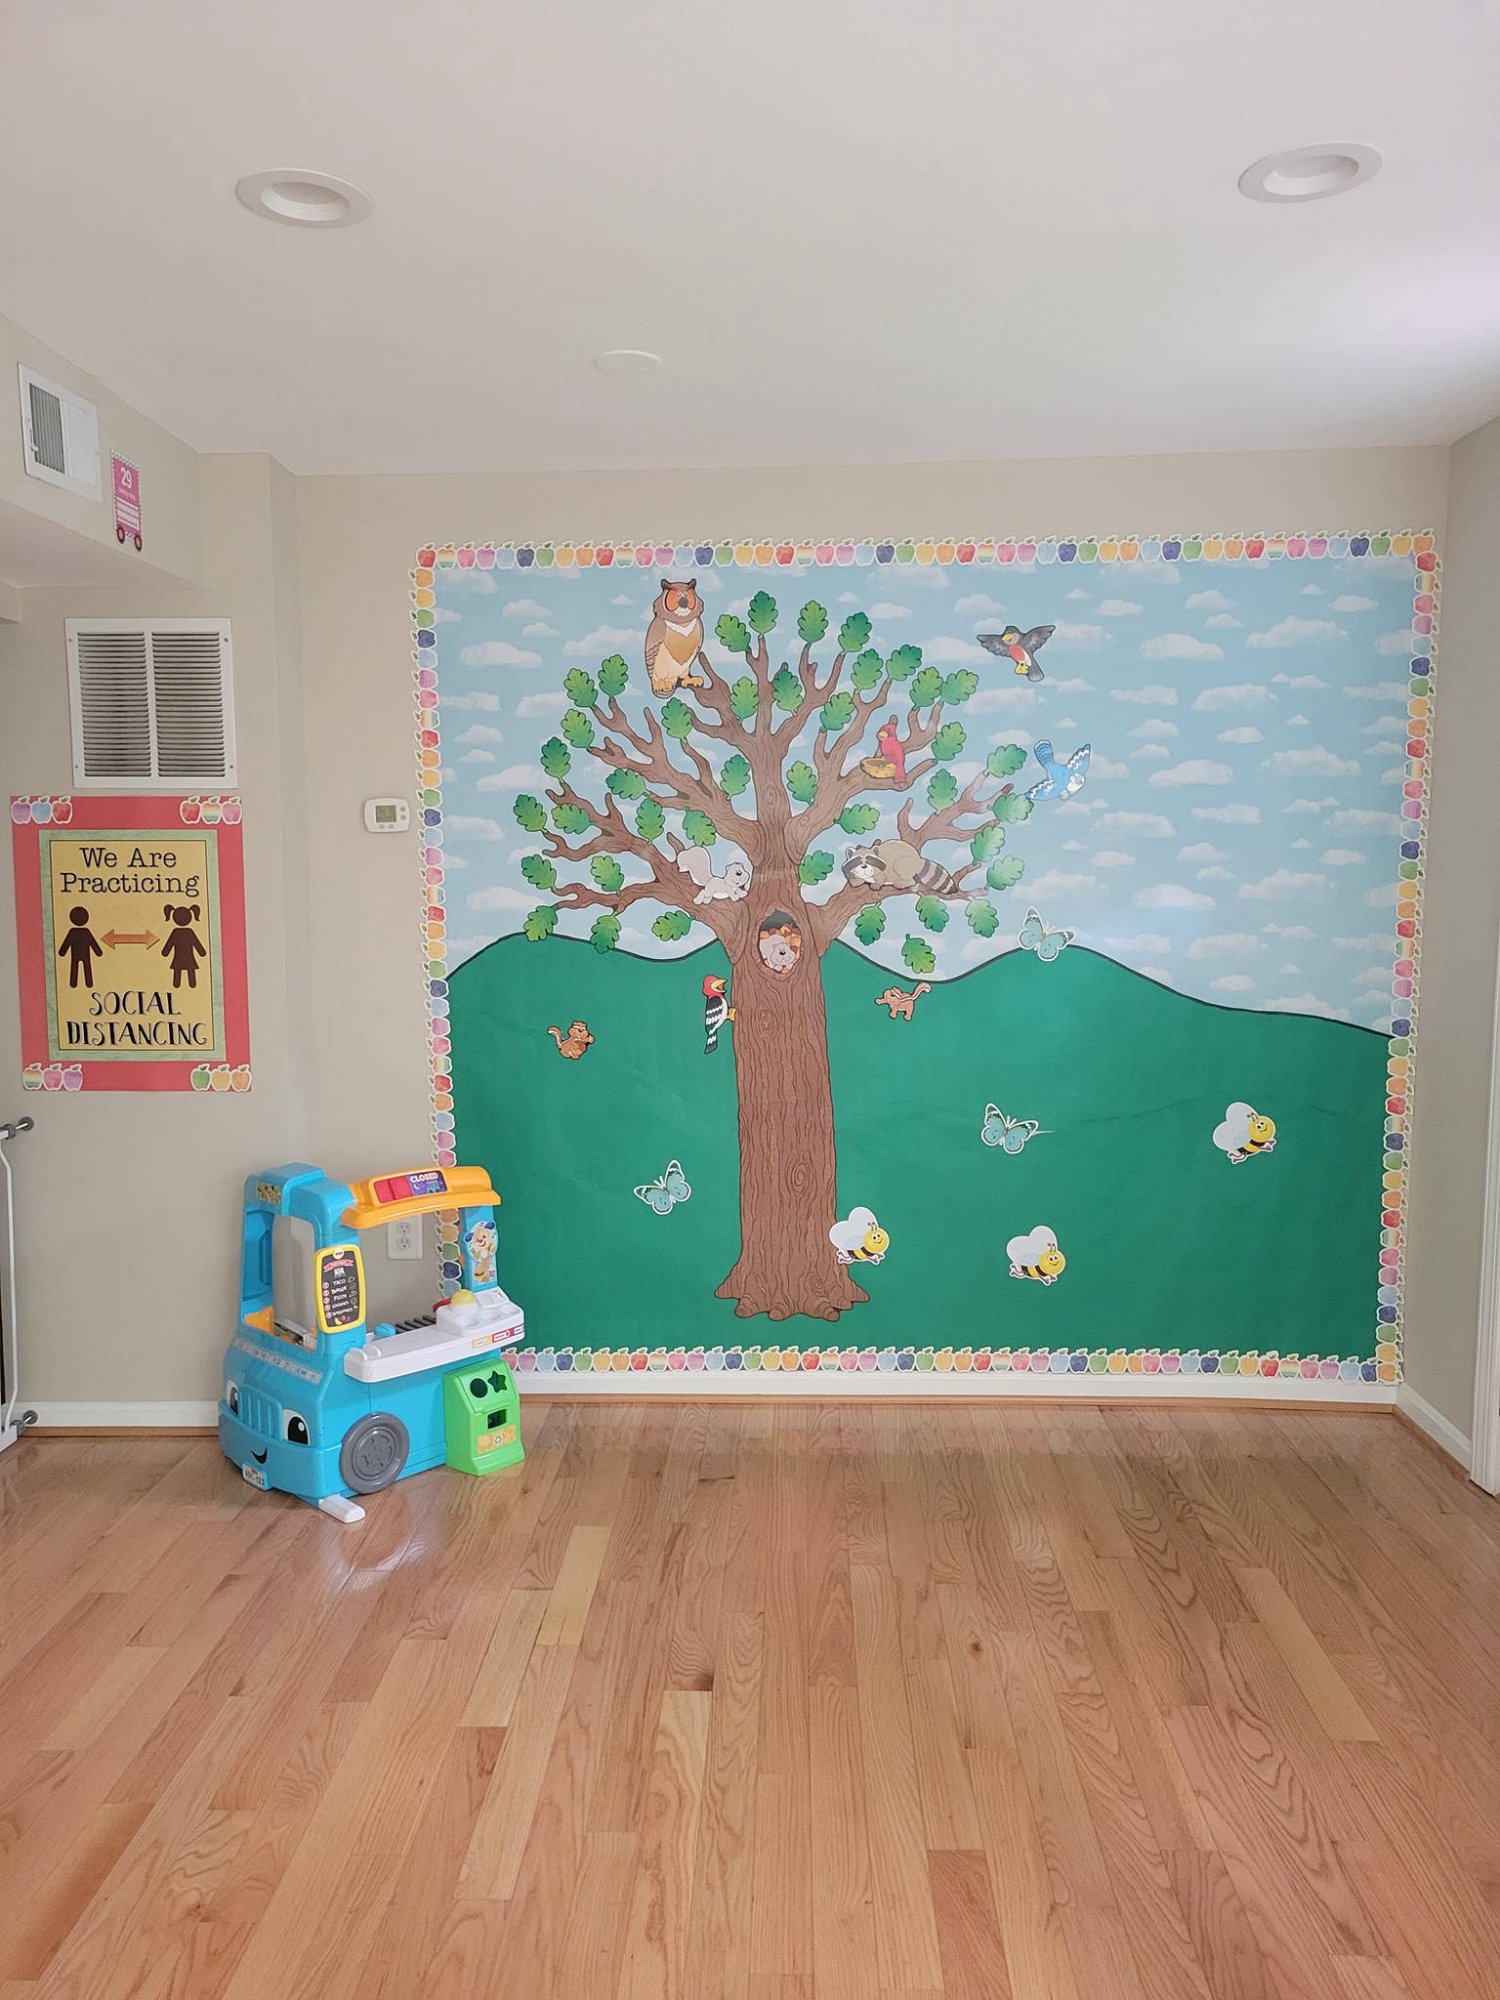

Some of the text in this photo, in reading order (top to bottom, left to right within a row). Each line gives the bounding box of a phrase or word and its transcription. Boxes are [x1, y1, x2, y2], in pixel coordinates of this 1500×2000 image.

[121, 467, 132, 489] 29
[79, 847, 177, 868] We Are
[60, 872, 200, 898] Practicing
[89, 990, 181, 1016] SOCIAL
[66, 1020, 207, 1046] DISTANCING
[410, 1172, 438, 1182] CLOSED
